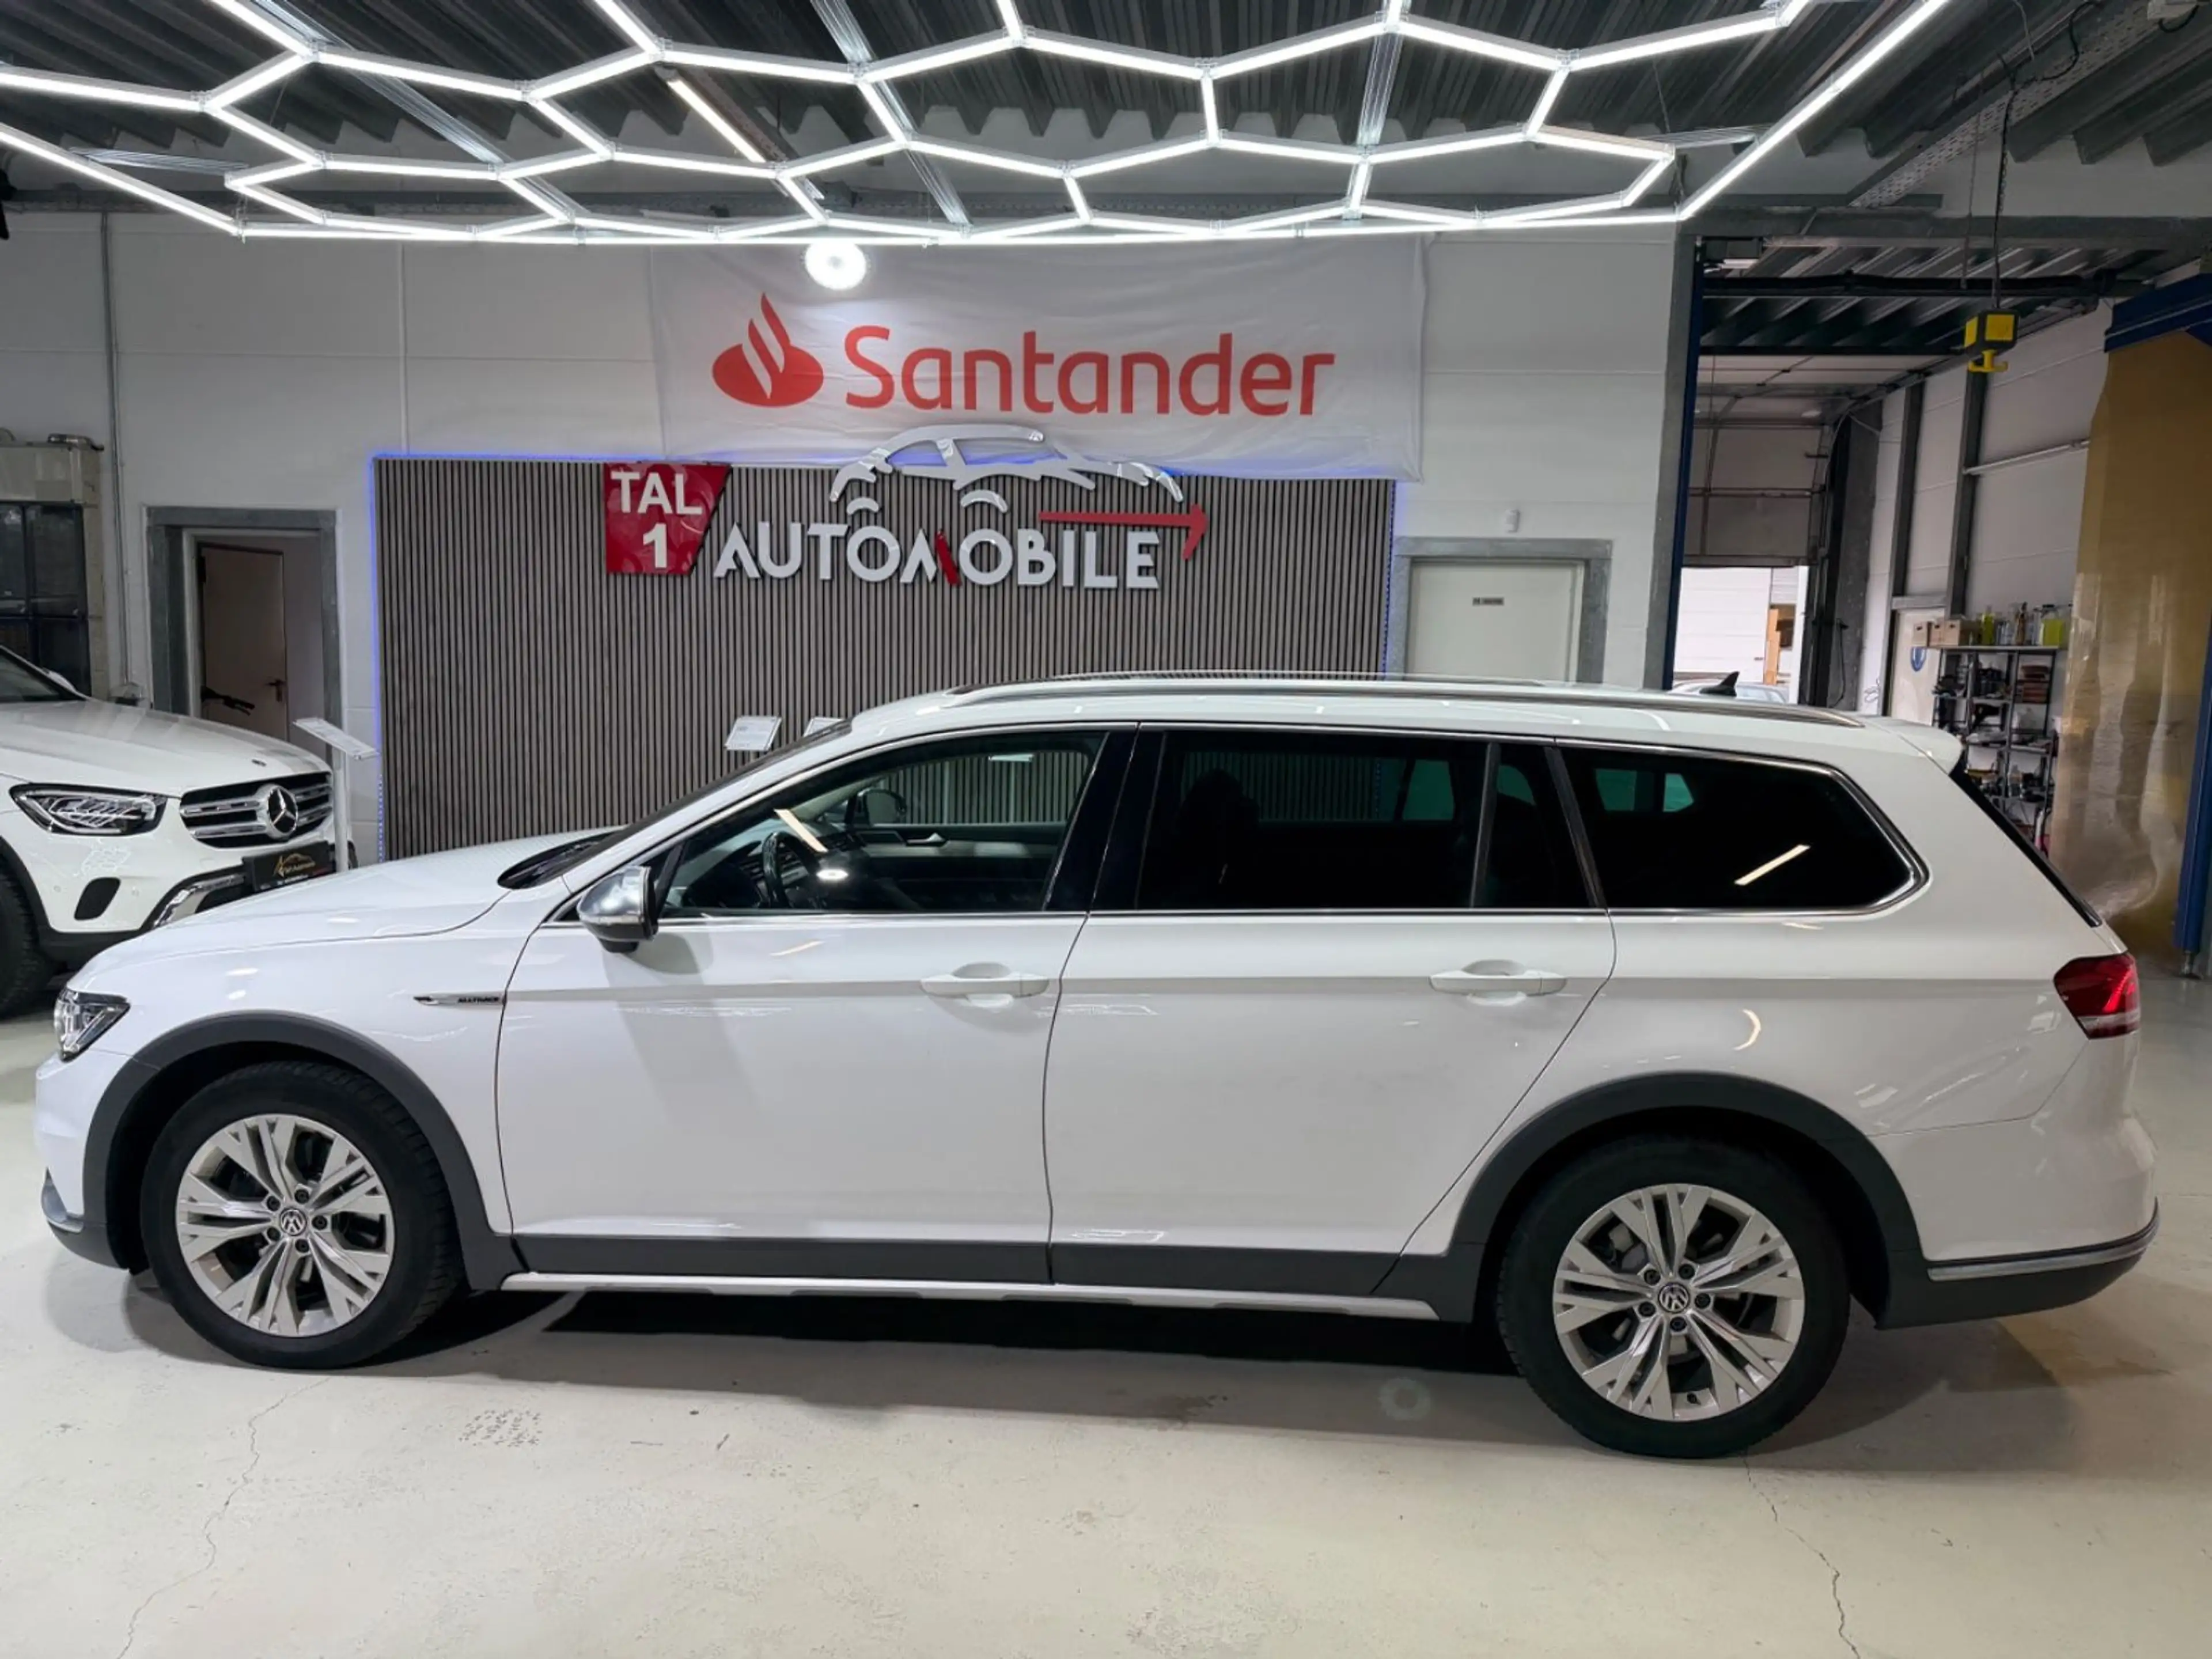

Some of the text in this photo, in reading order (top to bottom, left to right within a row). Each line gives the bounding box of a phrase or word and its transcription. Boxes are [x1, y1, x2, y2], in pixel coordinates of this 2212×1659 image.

[844, 325, 1335, 416] Santander
[610, 470, 703, 515] TAL
[643, 522, 667, 569] 1
[713, 520, 1160, 589] AUTOMOBILE
